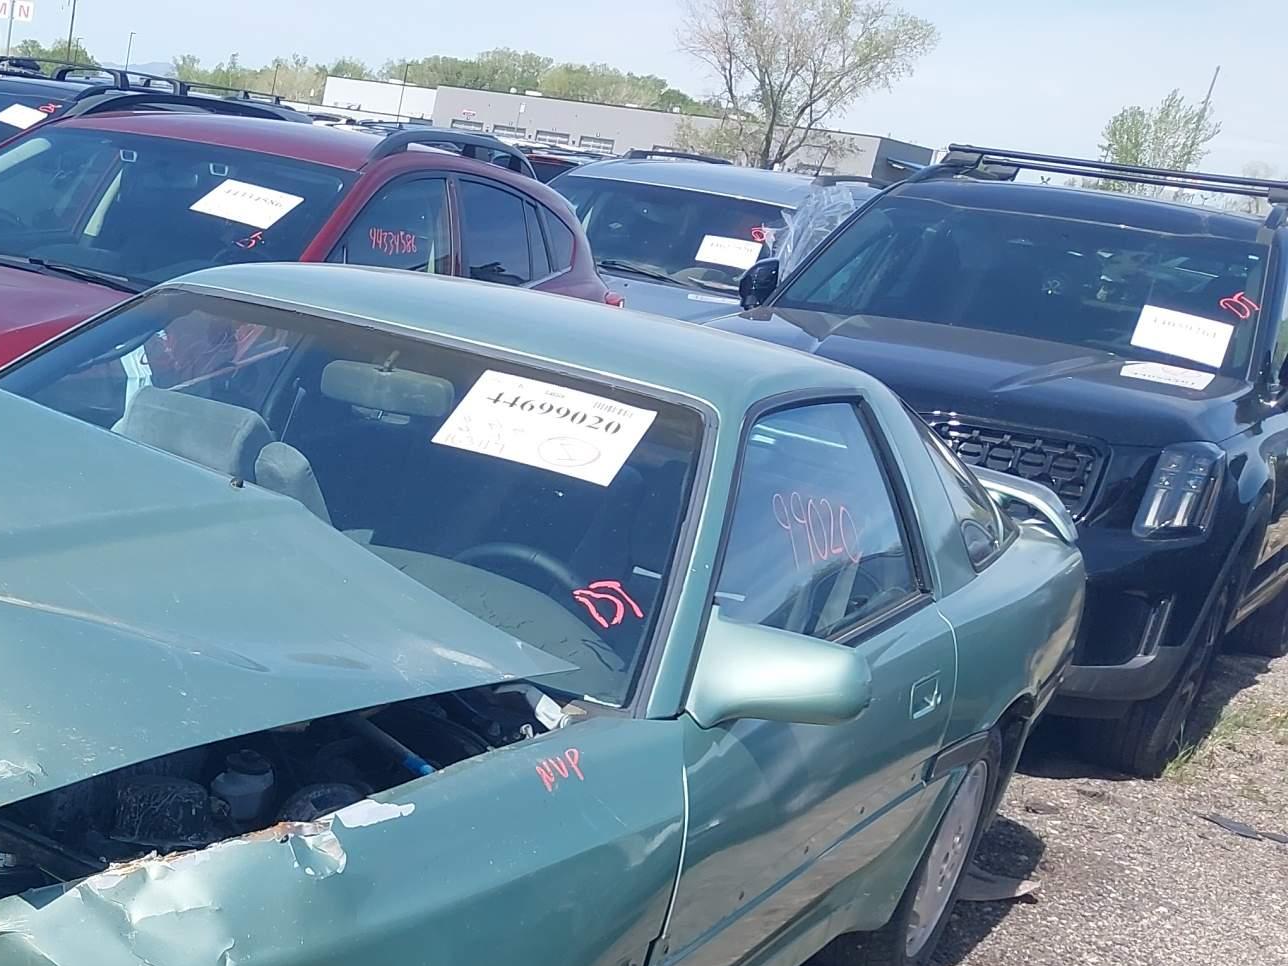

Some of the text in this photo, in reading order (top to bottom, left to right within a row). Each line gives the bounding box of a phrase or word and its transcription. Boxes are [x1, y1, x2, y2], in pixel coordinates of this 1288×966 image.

[18, 4, 30, 18] N
[486, 391, 621, 435] 44699020
[772, 491, 864, 570] 99020
